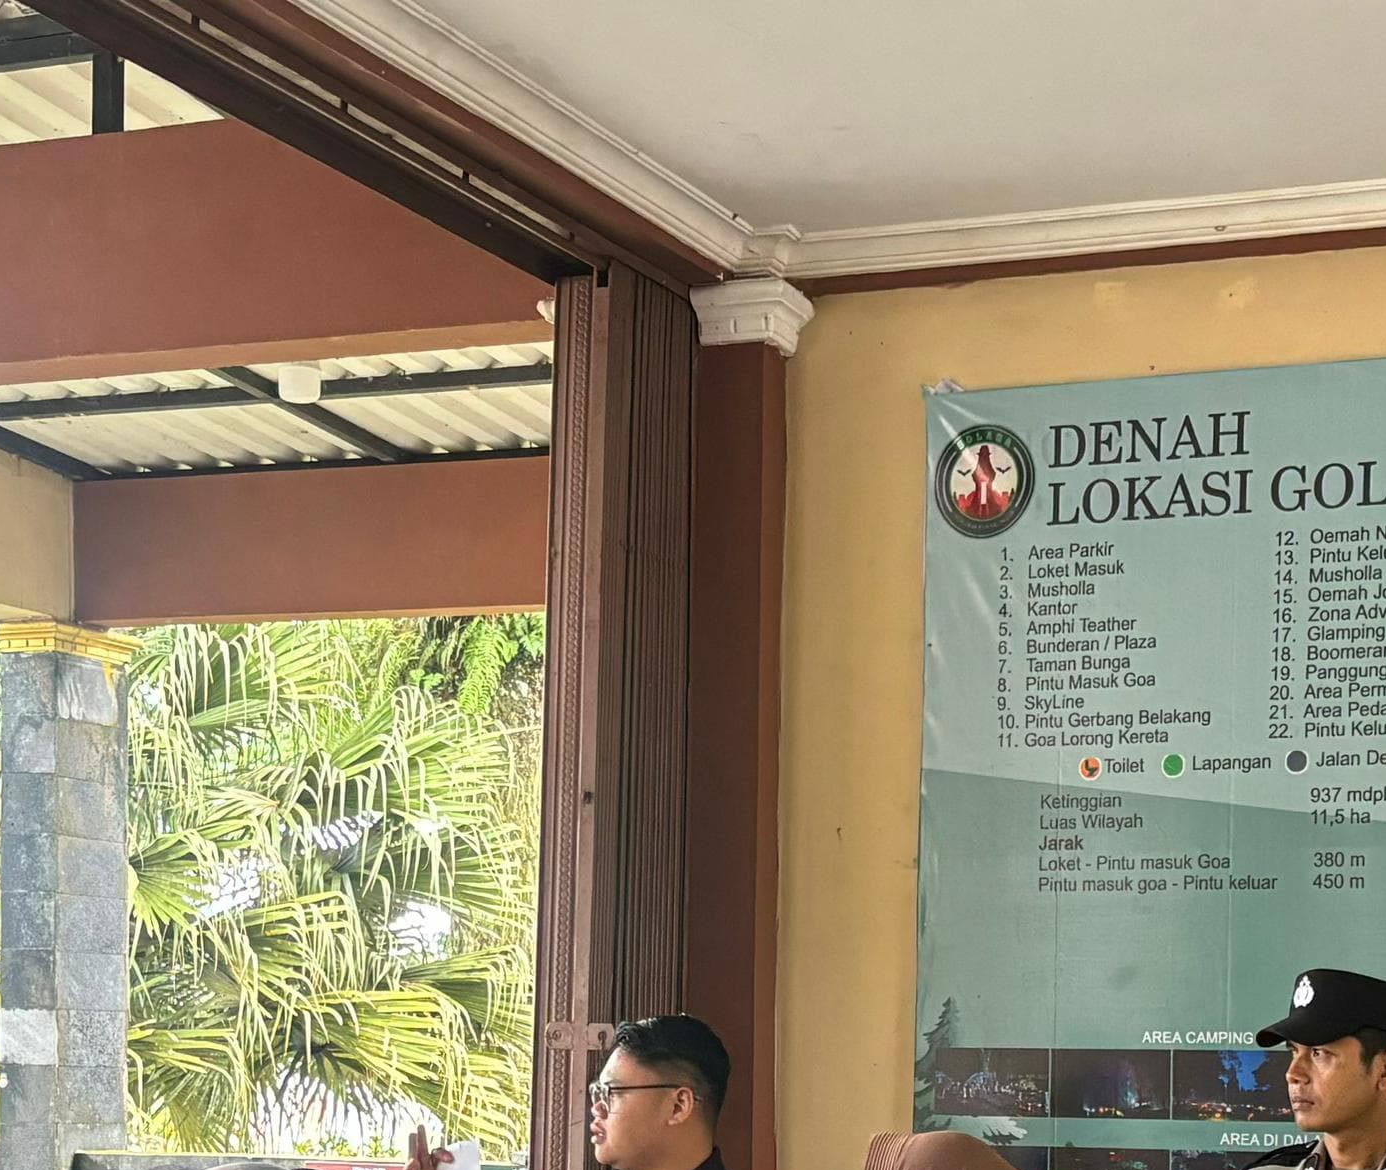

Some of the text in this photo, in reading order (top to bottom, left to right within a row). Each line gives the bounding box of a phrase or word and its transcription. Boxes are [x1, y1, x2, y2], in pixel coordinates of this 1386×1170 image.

[1048, 411, 1250, 468] DENAH
[1047, 470, 1253, 526] LOKASI
[1276, 531, 1298, 546] 12.
[1310, 527, 1370, 544] Oemah
[1002, 541, 1114, 562] 1. Area Parkir
[1276, 550, 1298, 565] 13.
[1311, 548, 1351, 564] Pintu
[1000, 560, 1124, 580] 2. Loket Masuk
[1275, 565, 1382, 585] 14. Musholla
[999, 580, 1094, 599] 3. Musholla
[1274, 589, 1297, 604] 15.
[1308, 585, 1367, 602] Oemah
[999, 601, 1078, 617] 4. Kantor
[1273, 608, 1296, 623] 16.
[1308, 607, 1350, 621] Zona
[999, 617, 1137, 637] 5. Amphi Teather
[1273, 627, 1296, 642] 17.
[1308, 624, 1385, 643] Glamping
[998, 641, 1012, 655] 6.
[1027, 638, 1099, 654] Bunderan
[1115, 635, 1156, 650] Plaza
[1272, 647, 1295, 662] 18.
[999, 655, 1130, 673] 7. Taman Bunga
[998, 672, 1155, 692] 8. Pintu Masuk Goa
[1272, 666, 1294, 681] 19.
[1270, 685, 1293, 700] 20.
[1304, 684, 1342, 699] Area
[997, 694, 1084, 713] 9. SkyLine
[1269, 704, 1293, 719] 21.
[1303, 704, 1342, 718] Area
[998, 709, 1210, 729] 10. Pintu Gerbang Belakang
[998, 730, 1168, 748] 11. Goa Lorong Kereta
[1269, 724, 1293, 738] 22.
[1305, 722, 1345, 738] Pintu
[1104, 758, 1144, 773] Toilet
[1193, 756, 1271, 773] Lapangan
[1316, 752, 1360, 767] Jalan
[1041, 793, 1121, 812] Ketinggian
[1311, 786, 1386, 805] 937 mdpl
[1040, 813, 1143, 832] Luas Wilayah
[1311, 808, 1370, 826] 11,5 ha
[1039, 835, 1084, 851] Jarak
[1039, 856, 1081, 871] Loket
[1097, 856, 1134, 870] Pintu
[1141, 854, 1192, 869] masuk
[1198, 854, 1230, 869] Goa
[1314, 852, 1365, 867] 380 m
[1039, 877, 1076, 892] Pintu
[1083, 876, 1133, 891] masuk
[1138, 879, 1166, 894] goa
[1184, 875, 1223, 890] Pintu
[1229, 875, 1278, 889] keluar
[1313, 874, 1364, 889] 450 m
[1142, 1031, 1253, 1045] AREA CAMPING
[1220, 1133, 1260, 1146] AREA
[1263, 1134, 1278, 1146] DI
